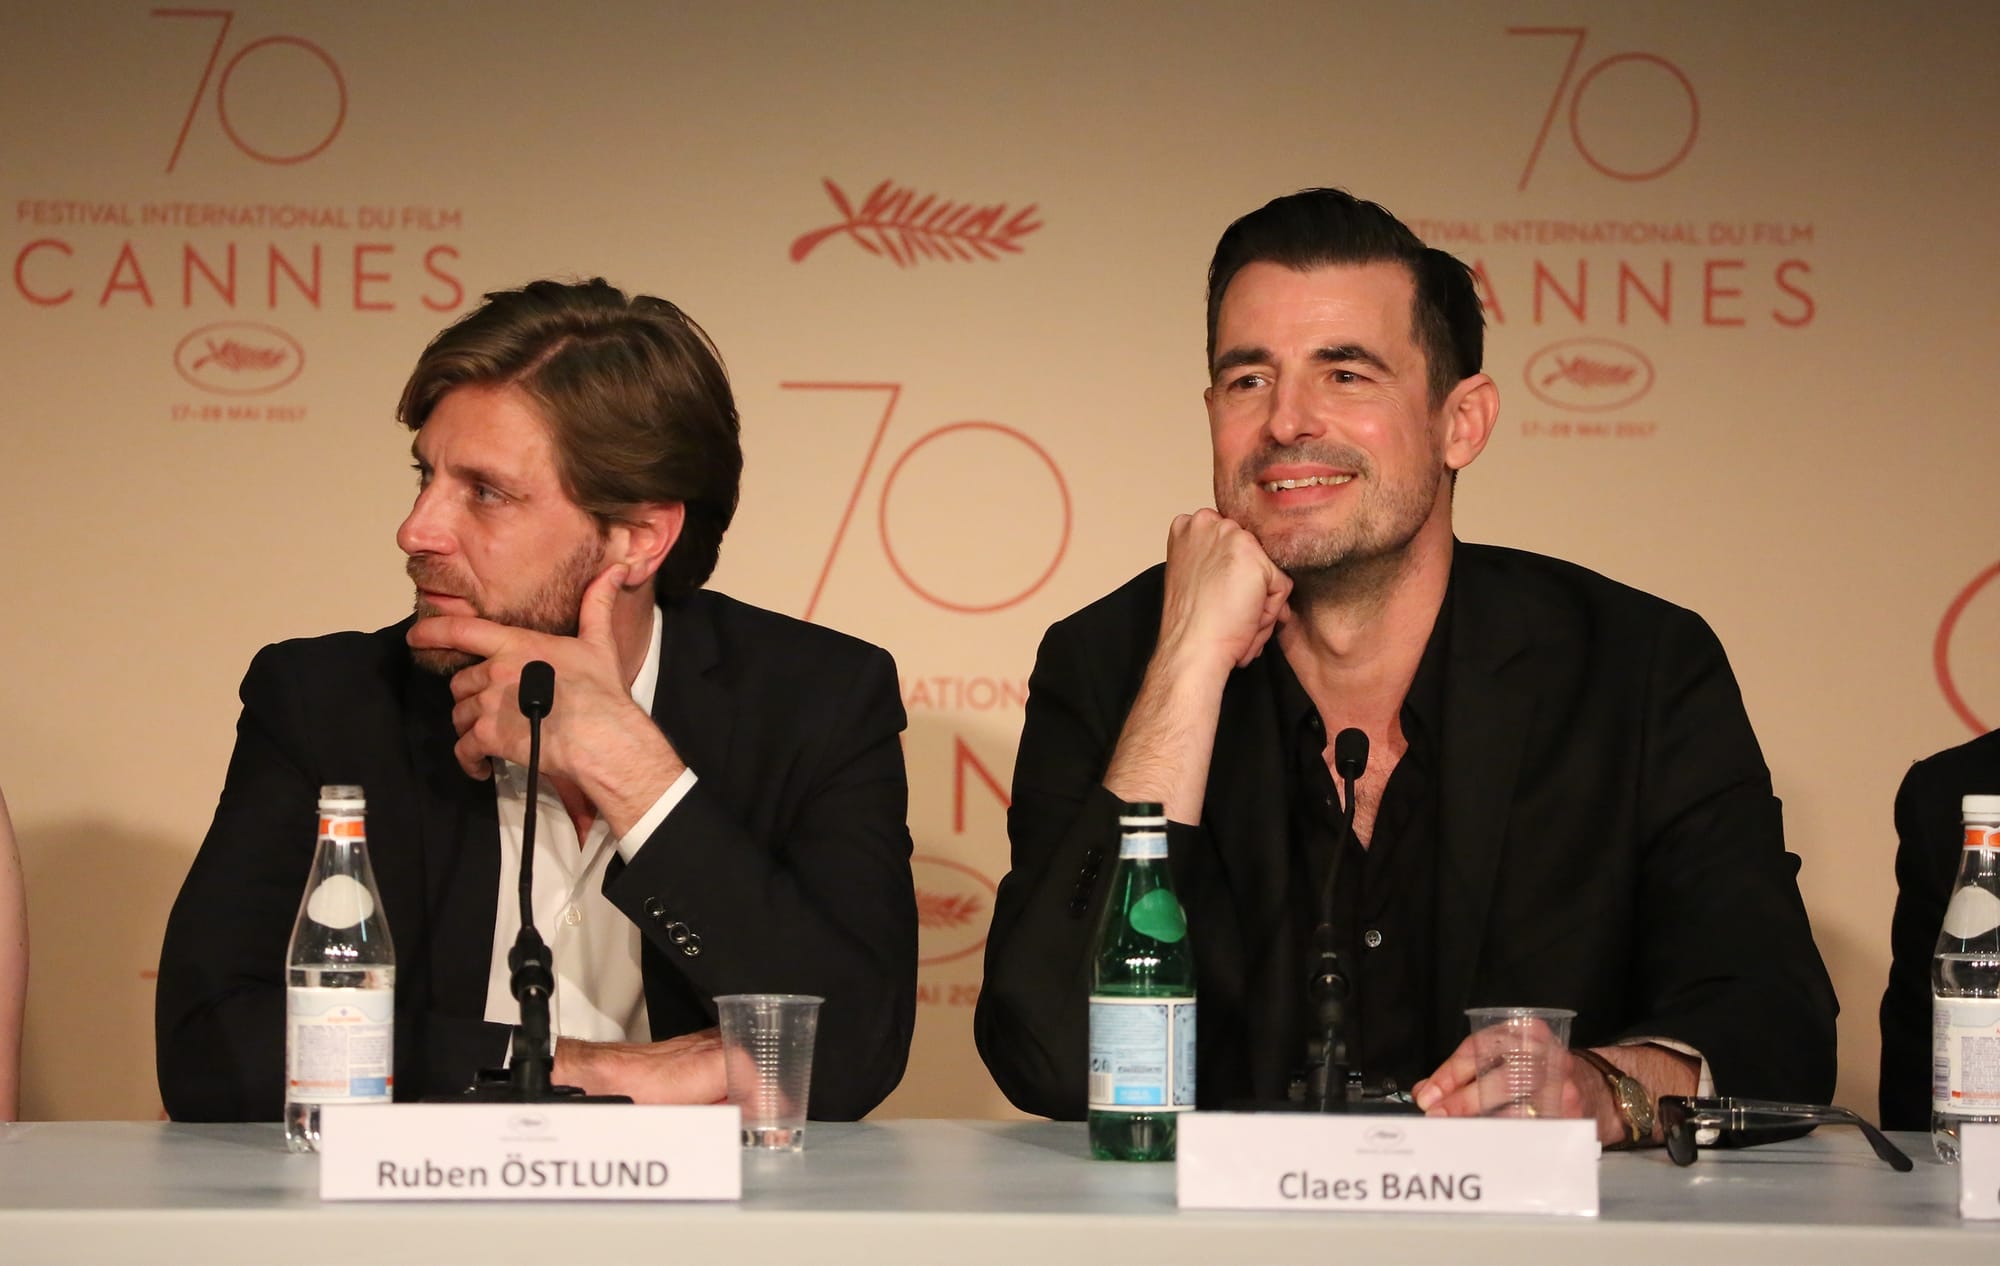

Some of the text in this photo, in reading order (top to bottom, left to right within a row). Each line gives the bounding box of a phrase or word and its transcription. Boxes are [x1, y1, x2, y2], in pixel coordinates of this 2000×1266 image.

[150, 8, 348, 174] 70
[1505, 26, 1701, 192] 70
[16, 199, 463, 230] FESTIVAL INTERNATIONAL DU FILM
[1404, 219, 1815, 246] TIVAL INTERNATIONAL DU FILM
[13, 237, 465, 313] CANNES
[1472, 257, 1817, 329] ANNES
[779, 381, 1073, 621] 70
[377, 1153, 669, 1188] Ruben ÖSTLUND
[1279, 1171, 1482, 1201] Claes BANG
